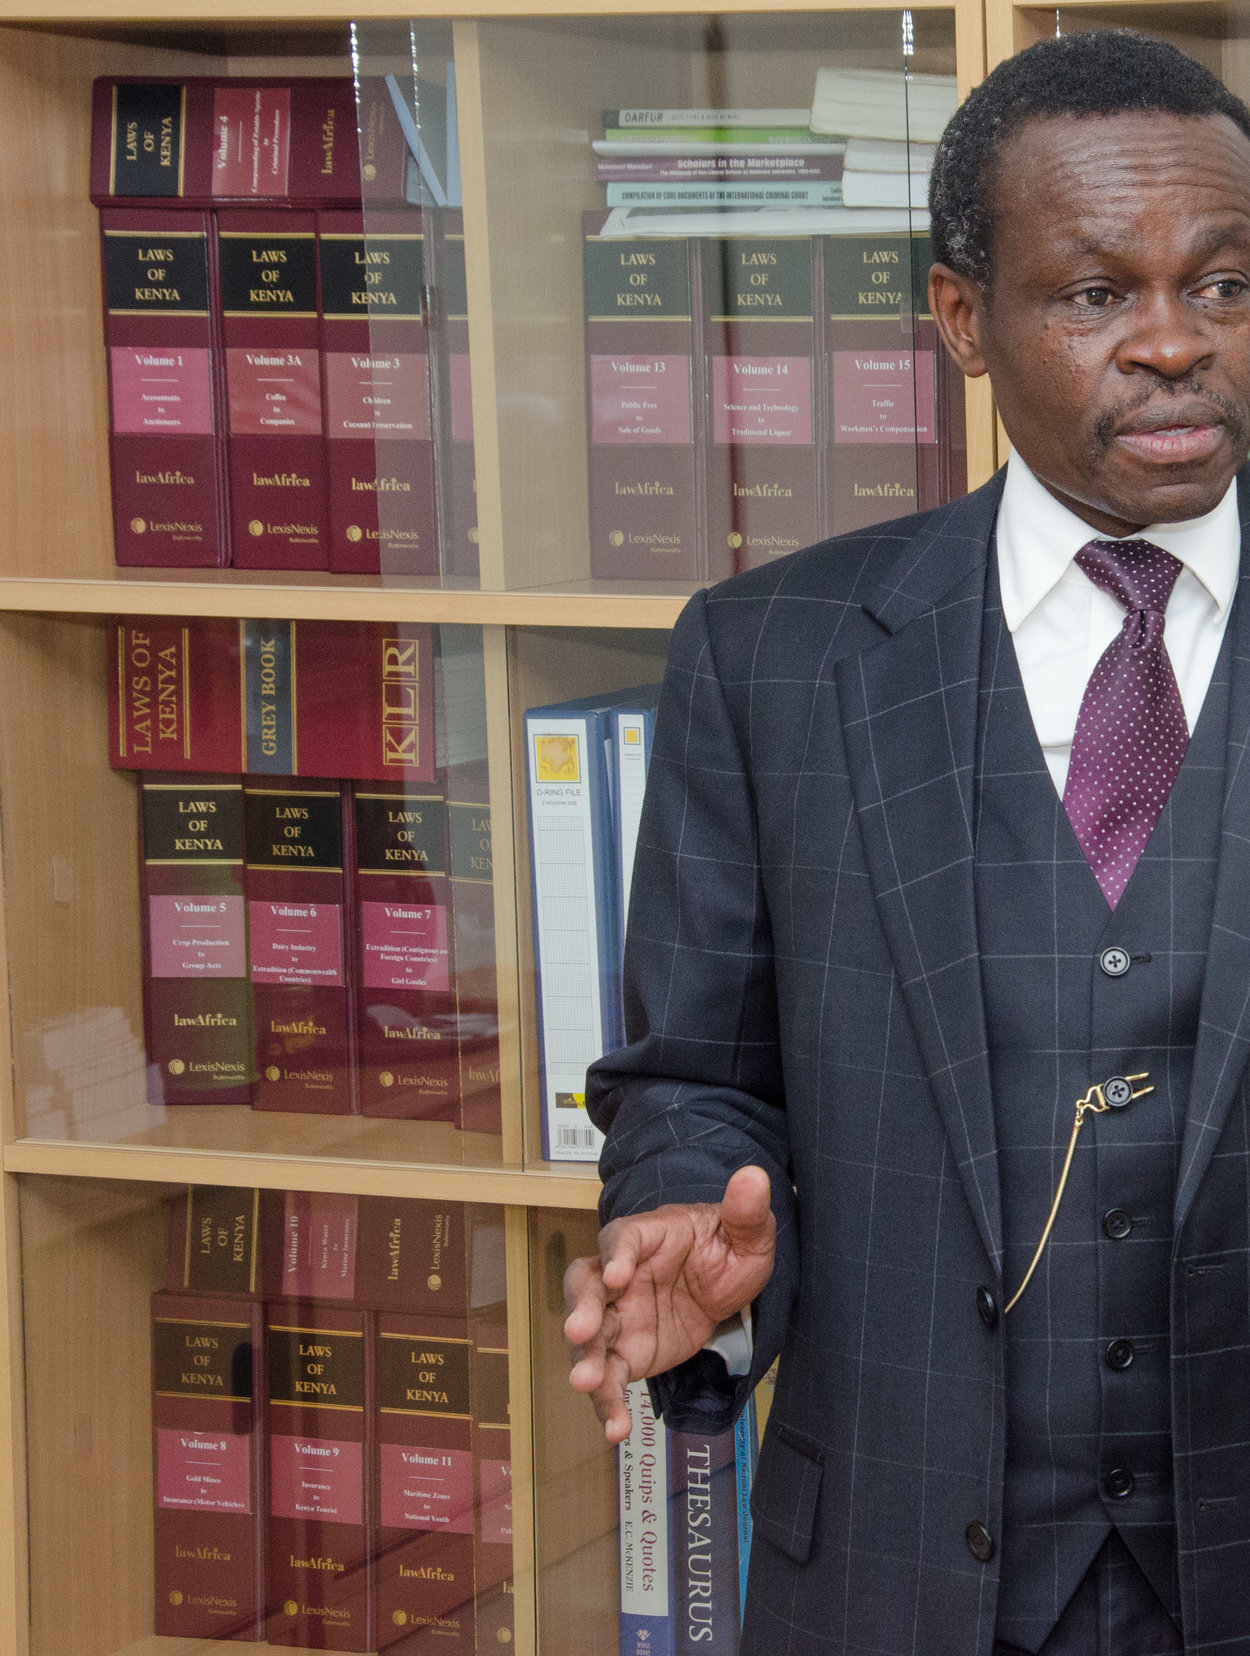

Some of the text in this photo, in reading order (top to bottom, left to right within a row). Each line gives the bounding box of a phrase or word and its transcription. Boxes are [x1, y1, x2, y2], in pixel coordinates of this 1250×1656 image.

[624, 112, 663, 123] DARFUR
[677, 157, 805, 169] Scholars in the Marketplace
[138, 249, 174, 261] LAWS
[252, 250, 287, 263] LAWS
[620, 253, 656, 266] LAWS
[741, 253, 777, 266] LAWS
[147, 268, 166, 281] OF
[261, 270, 280, 282] OF
[629, 273, 648, 286] OF
[750, 273, 769, 286] OF
[135, 288, 180, 300] KENYA
[249, 289, 294, 302] KENYA
[616, 293, 663, 306] KENYA
[736, 293, 783, 306] KENYA
[135, 355, 183, 367] Volume 1
[246, 354, 302, 367] Volume 3A
[610, 361, 666, 373] Volume 13
[854, 359, 911, 371] Volume 15
[733, 363, 789, 375] Volume 14
[135, 470, 195, 485] lawAfrica
[253, 472, 310, 488] lawAfrica
[150, 520, 204, 534] LexisNexis
[267, 522, 319, 536] LexisNexis
[132, 630, 151, 754] LAWS OF
[158, 645, 178, 741] KENYA
[260, 637, 277, 756] GREY BOOK
[383, 639, 419, 766] KLR
[536, 788, 582, 796] D-RING FILE
[178, 801, 216, 813] LAWS
[275, 807, 309, 820] LAWS
[388, 811, 422, 824] LAWS
[188, 819, 209, 832] OF
[284, 825, 302, 838] OF
[397, 830, 415, 843] OF
[174, 838, 223, 851] KENYA
[271, 844, 315, 857] KENYA
[384, 848, 429, 862] KENYA
[174, 902, 227, 913] Volume 5
[270, 906, 317, 919] Volume 6
[384, 907, 432, 920] Volume 7
[174, 1013, 238, 1027] lawAfrica
[188, 1061, 246, 1073] LexisNexis
[299, 1344, 332, 1358] LAWS
[411, 1352, 444, 1365] LAWS
[307, 1363, 324, 1376] OF
[419, 1370, 437, 1383] OF
[294, 1381, 337, 1395] KENYA
[406, 1389, 449, 1403] KENYA
[294, 1443, 340, 1457] Volume 9
[401, 1453, 453, 1466] Volume 11
[638, 1390, 658, 1592] 14,000 Quips & Quotes
[623, 1450, 634, 1593] & Speakers E.C. McKENZIE
[687, 1444, 713, 1642] THESAURUS
[290, 1554, 345, 1572] lawAfrica
